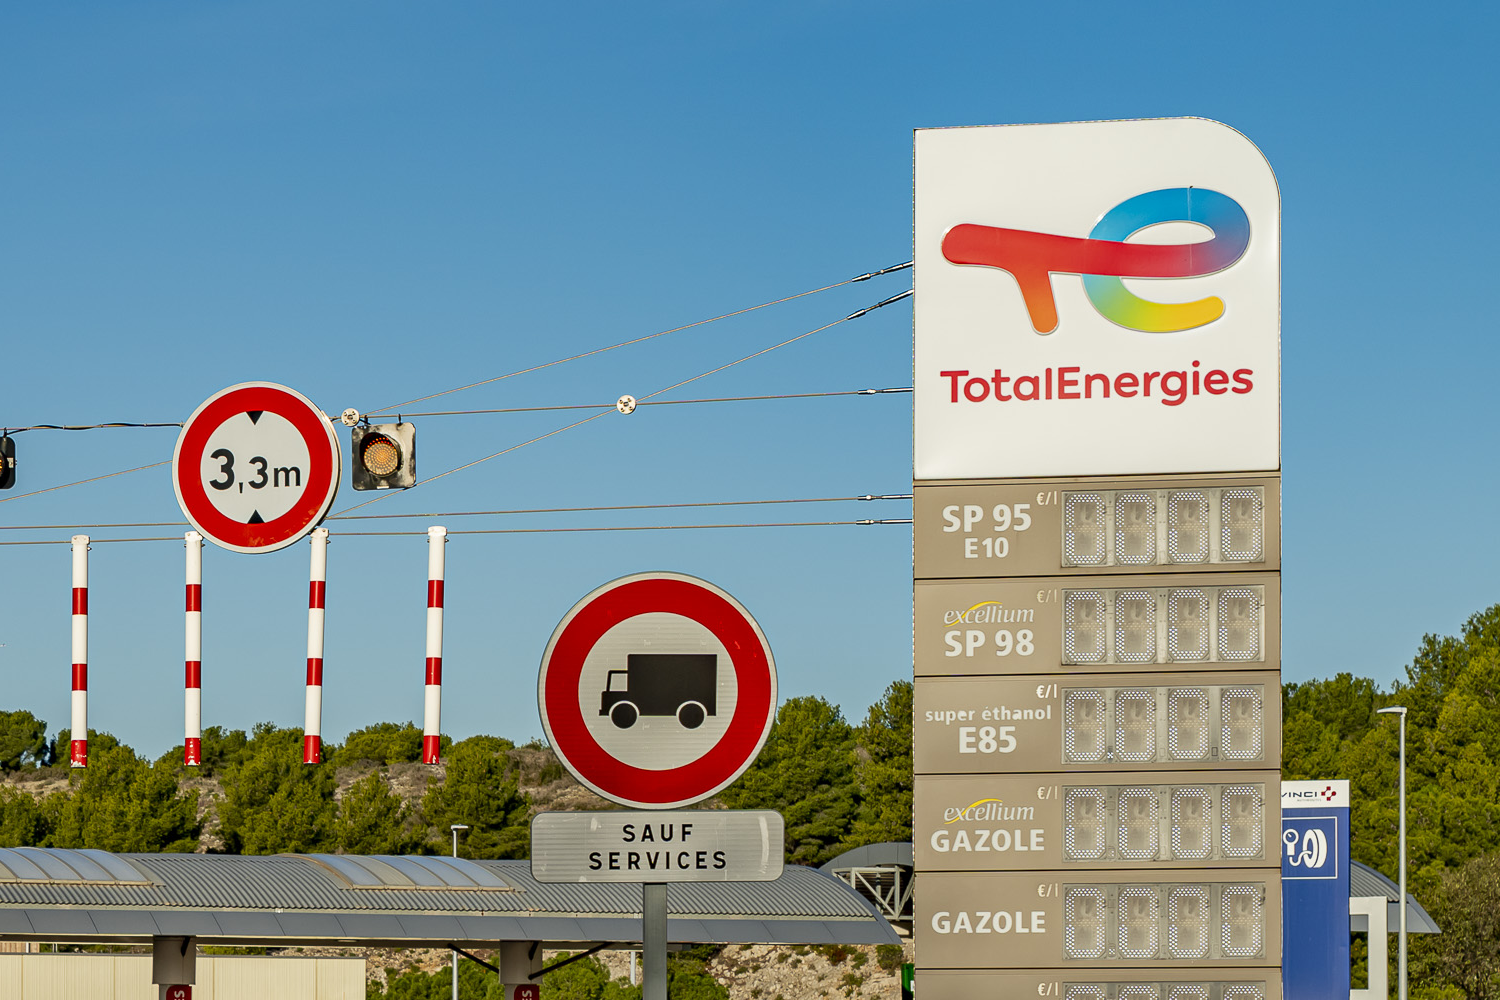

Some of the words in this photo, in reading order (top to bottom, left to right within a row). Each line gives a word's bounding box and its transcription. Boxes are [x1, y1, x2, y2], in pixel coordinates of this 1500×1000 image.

[940, 360, 1254, 407] TotalEnergies
[209, 448, 301, 494] 3,3m
[942, 504, 984, 533] SP
[992, 503, 1032, 531] 95
[944, 603, 1034, 626] excellium
[944, 631, 985, 657] SP
[995, 629, 1035, 656] 98
[925, 708, 975, 725] super
[984, 704, 1051, 721] éthanol
[959, 726, 1017, 754] E85
[944, 800, 1034, 822] excellium
[622, 823, 694, 843] SAUF
[930, 829, 1045, 853] GAZOLE
[588, 851, 727, 870] SERVICES
[931, 911, 1046, 934] GAZOLE
